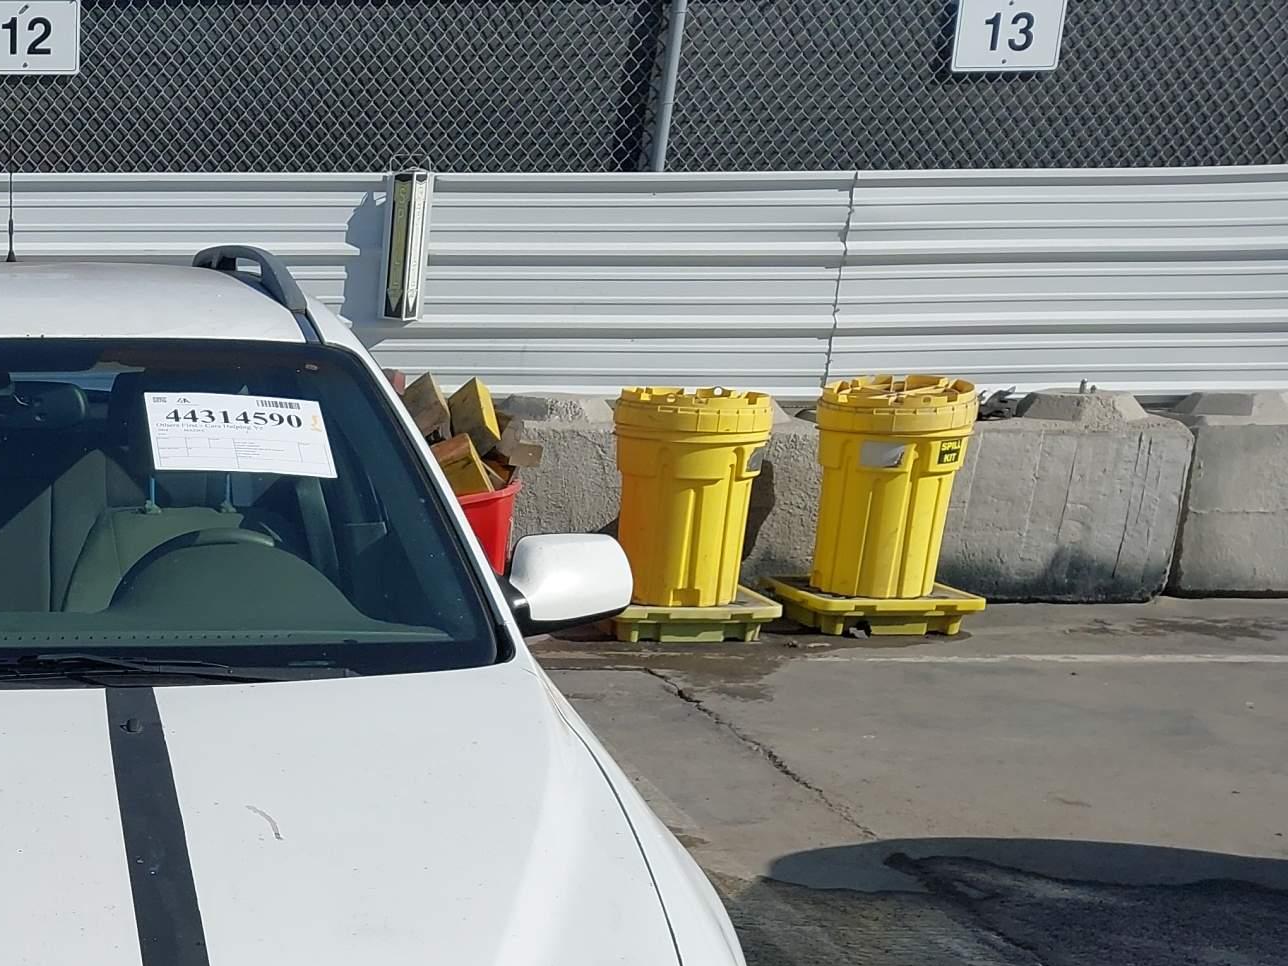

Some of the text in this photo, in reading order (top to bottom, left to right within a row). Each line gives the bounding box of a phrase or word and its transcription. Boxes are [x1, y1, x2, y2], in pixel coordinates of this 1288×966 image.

[2, 17, 52, 55] 12
[985, 12, 1034, 51] 13
[165, 408, 302, 428] 44314590
[941, 441, 961, 451] SPILL
[943, 453, 957, 463] KIT
